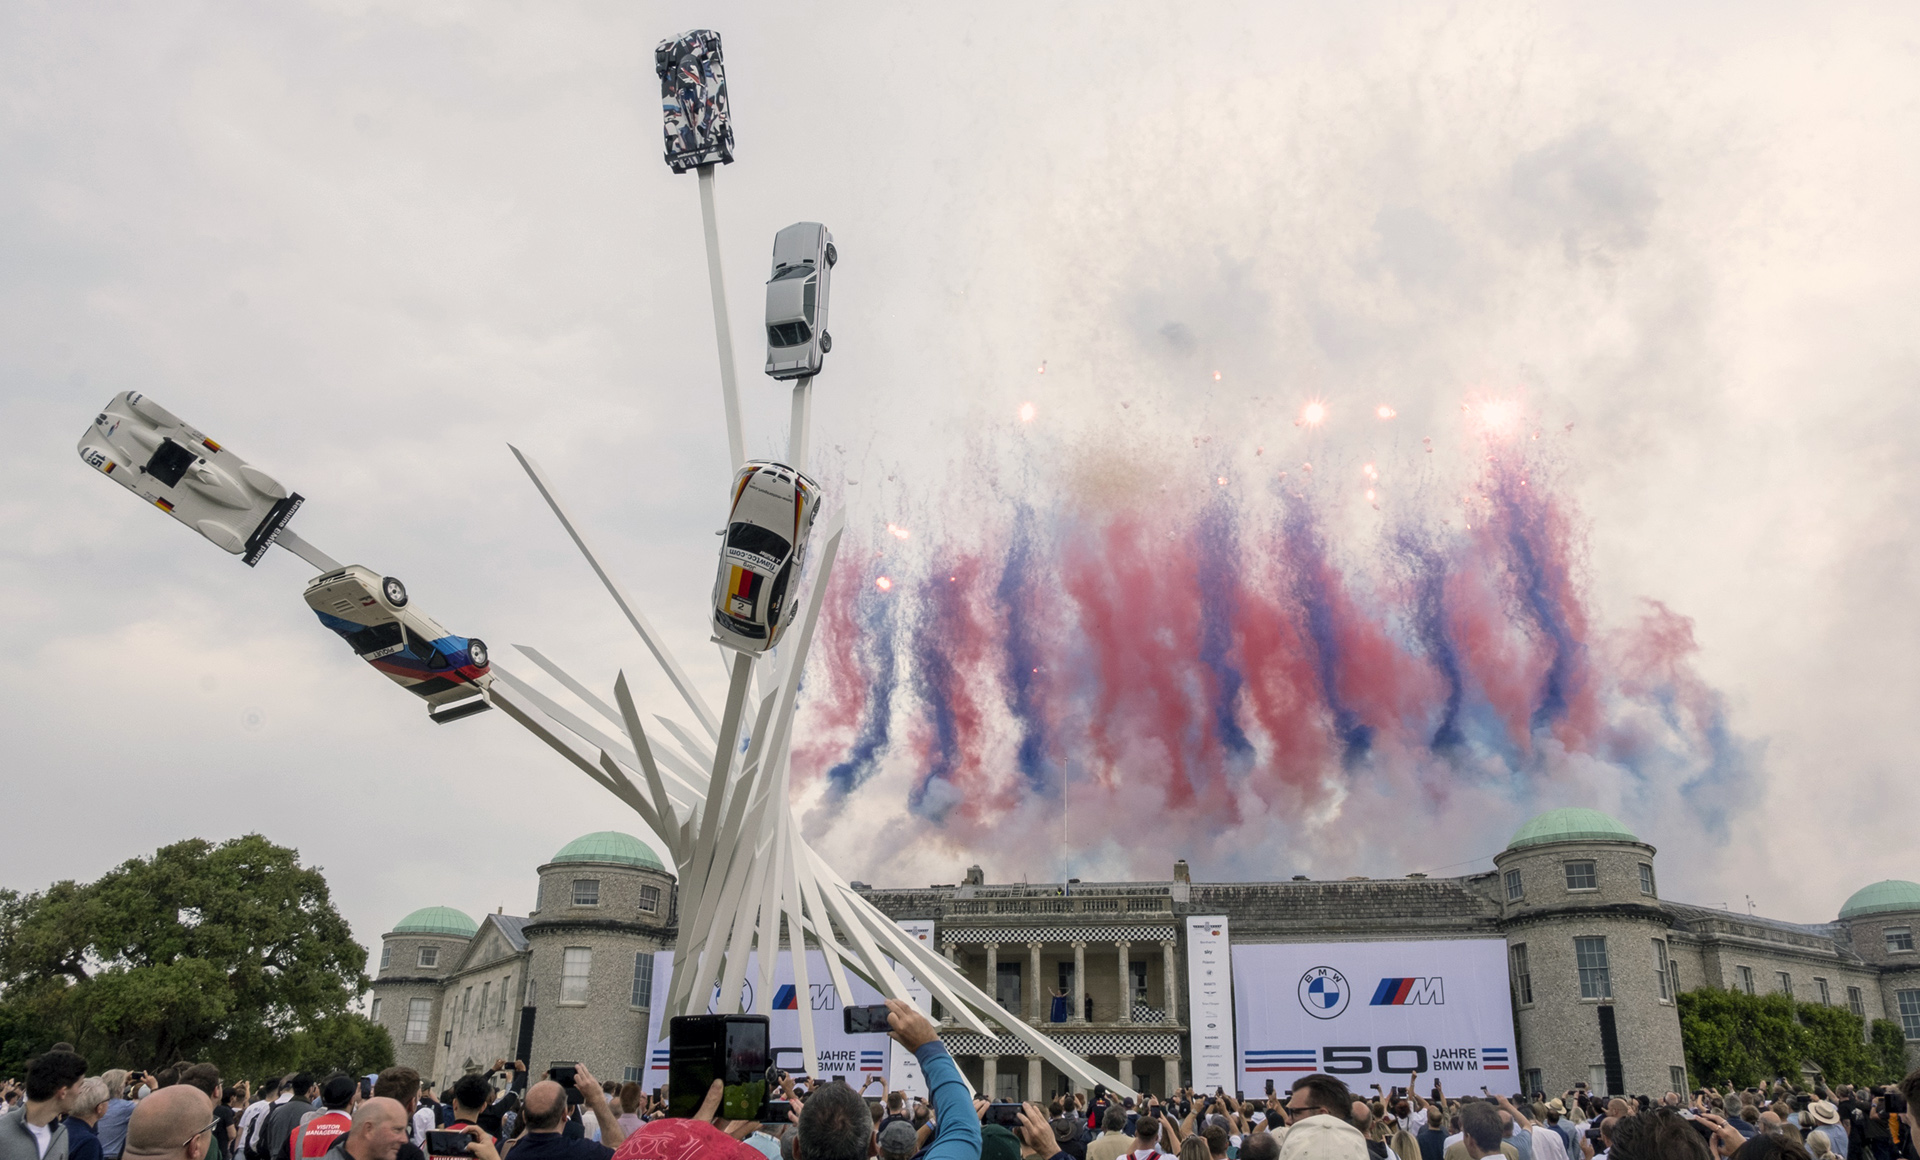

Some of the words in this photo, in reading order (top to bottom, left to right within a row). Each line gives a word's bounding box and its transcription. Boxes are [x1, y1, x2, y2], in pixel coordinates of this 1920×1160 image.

[91, 454, 106, 468] 15
[280, 499, 303, 527] Genuine
[265, 525, 281, 547] BMW
[249, 544, 267, 565] parts
[738, 602, 744, 611] 2
[1304, 968, 1343, 984] BMW
[817, 1051, 856, 1061] JAHRE
[1322, 1045, 1429, 1075] 50
[1432, 1048, 1477, 1060] JAHRE
[846, 1062, 856, 1071] M
[1433, 1060, 1465, 1071] BMW
[1466, 1060, 1478, 1070] M
